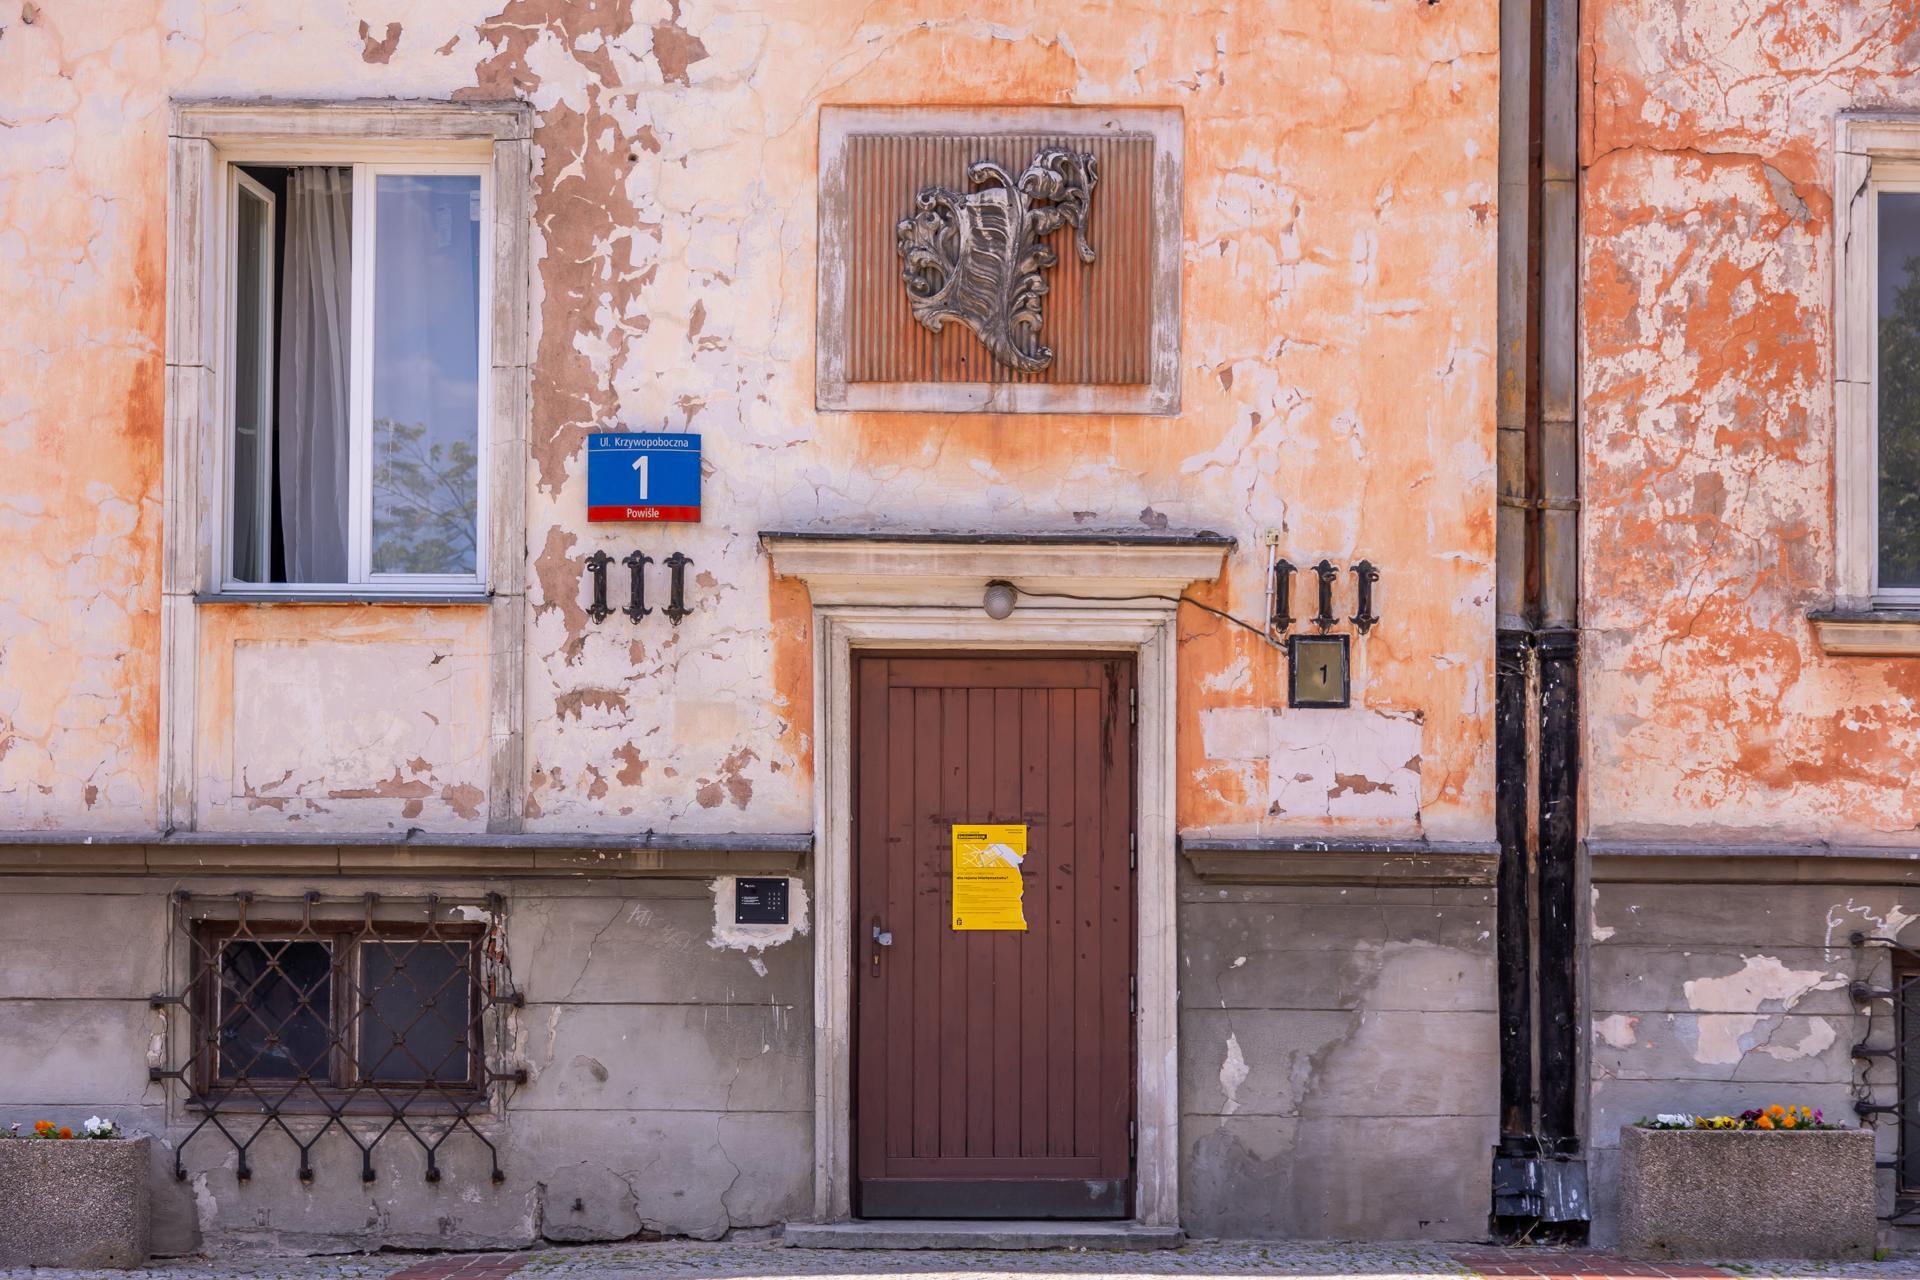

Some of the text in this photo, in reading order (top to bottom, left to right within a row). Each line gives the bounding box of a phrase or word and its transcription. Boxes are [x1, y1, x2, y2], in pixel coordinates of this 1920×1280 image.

[600, 437, 689, 448] Ul. Krzywopoboczna
[631, 455, 648, 500] 1
[626, 508, 660, 518] Powiśle
[1319, 664, 1327, 685] 1
